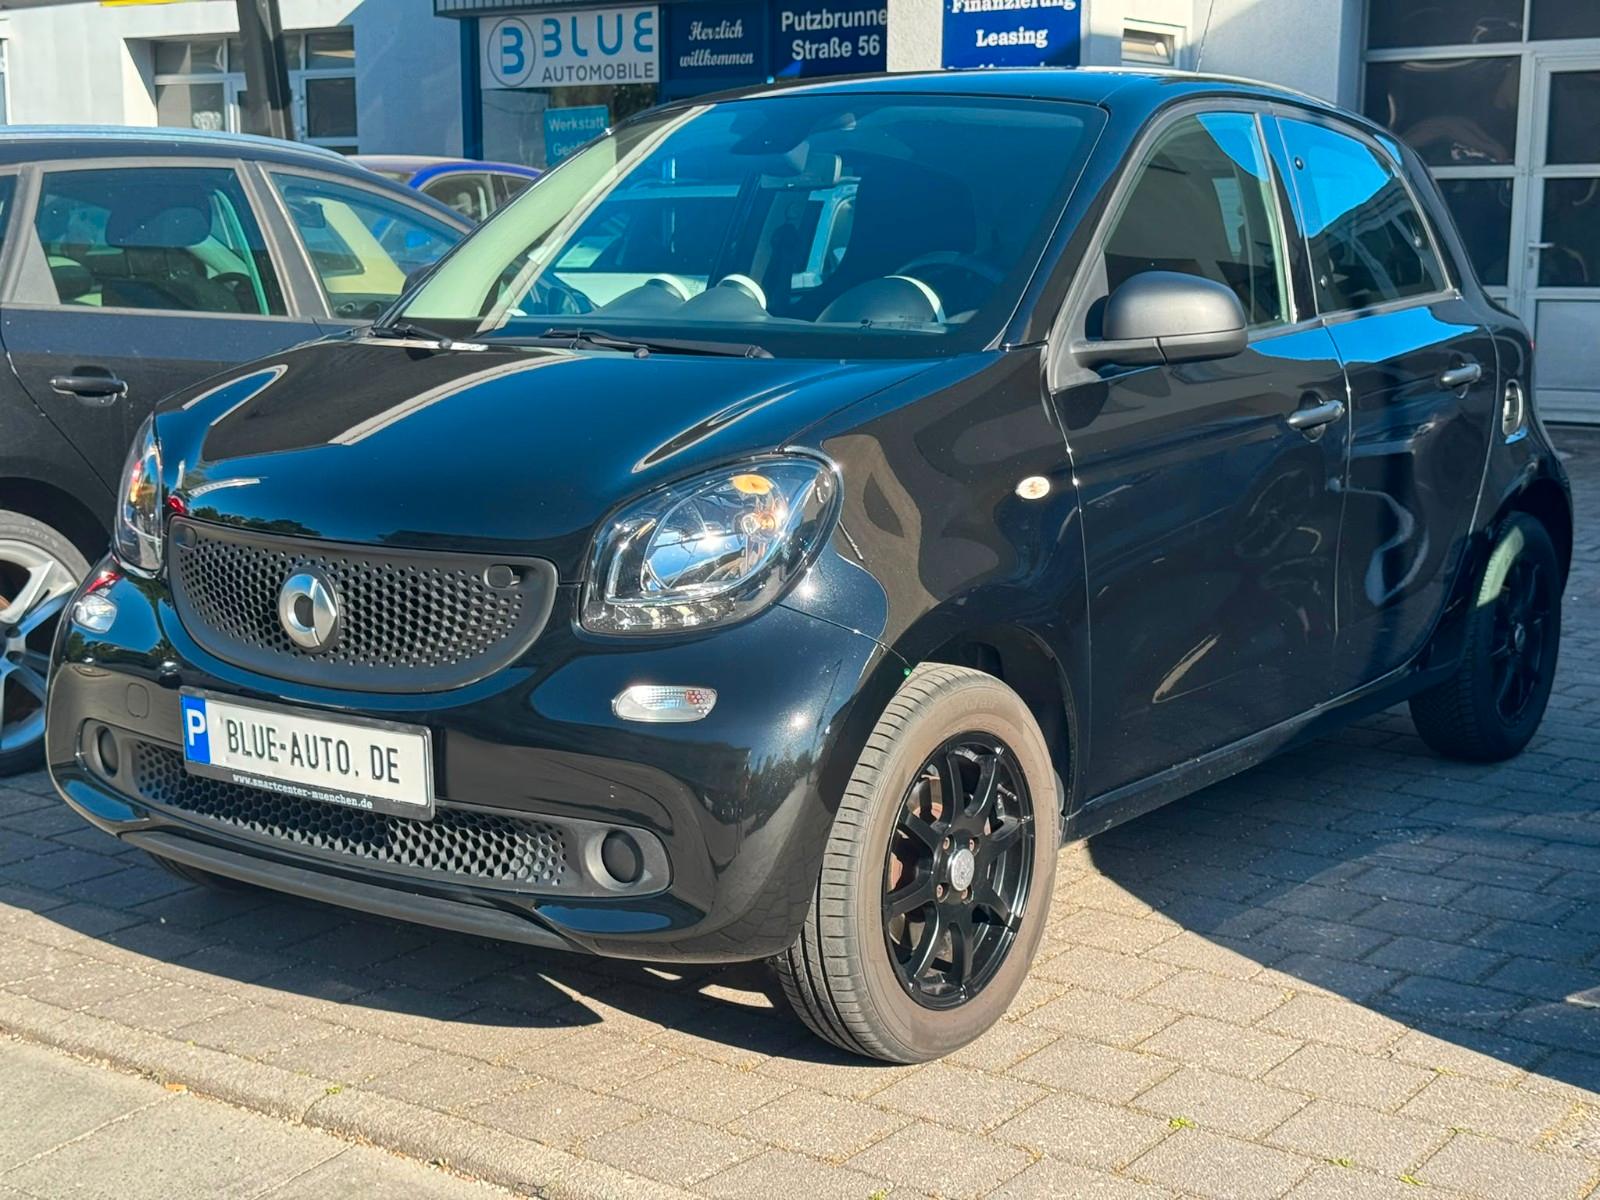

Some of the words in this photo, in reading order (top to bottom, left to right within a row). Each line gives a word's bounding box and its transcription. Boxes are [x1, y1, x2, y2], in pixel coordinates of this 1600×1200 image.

[952, 0, 1076, 13] Finanzierung
[543, 11, 653, 58] BLUE
[688, 19, 743, 41] Herzlich
[975, 26, 1049, 48] Leasing
[792, 37, 852, 60] Straße
[858, 34, 880, 56] 56
[679, 49, 754, 68] willkommen
[541, 62, 654, 82] AUTOMOBILE
[548, 116, 604, 132] Werkstatt
[186, 708, 206, 746] P
[232, 773, 373, 809] www.smartcenter-muenchen.de
